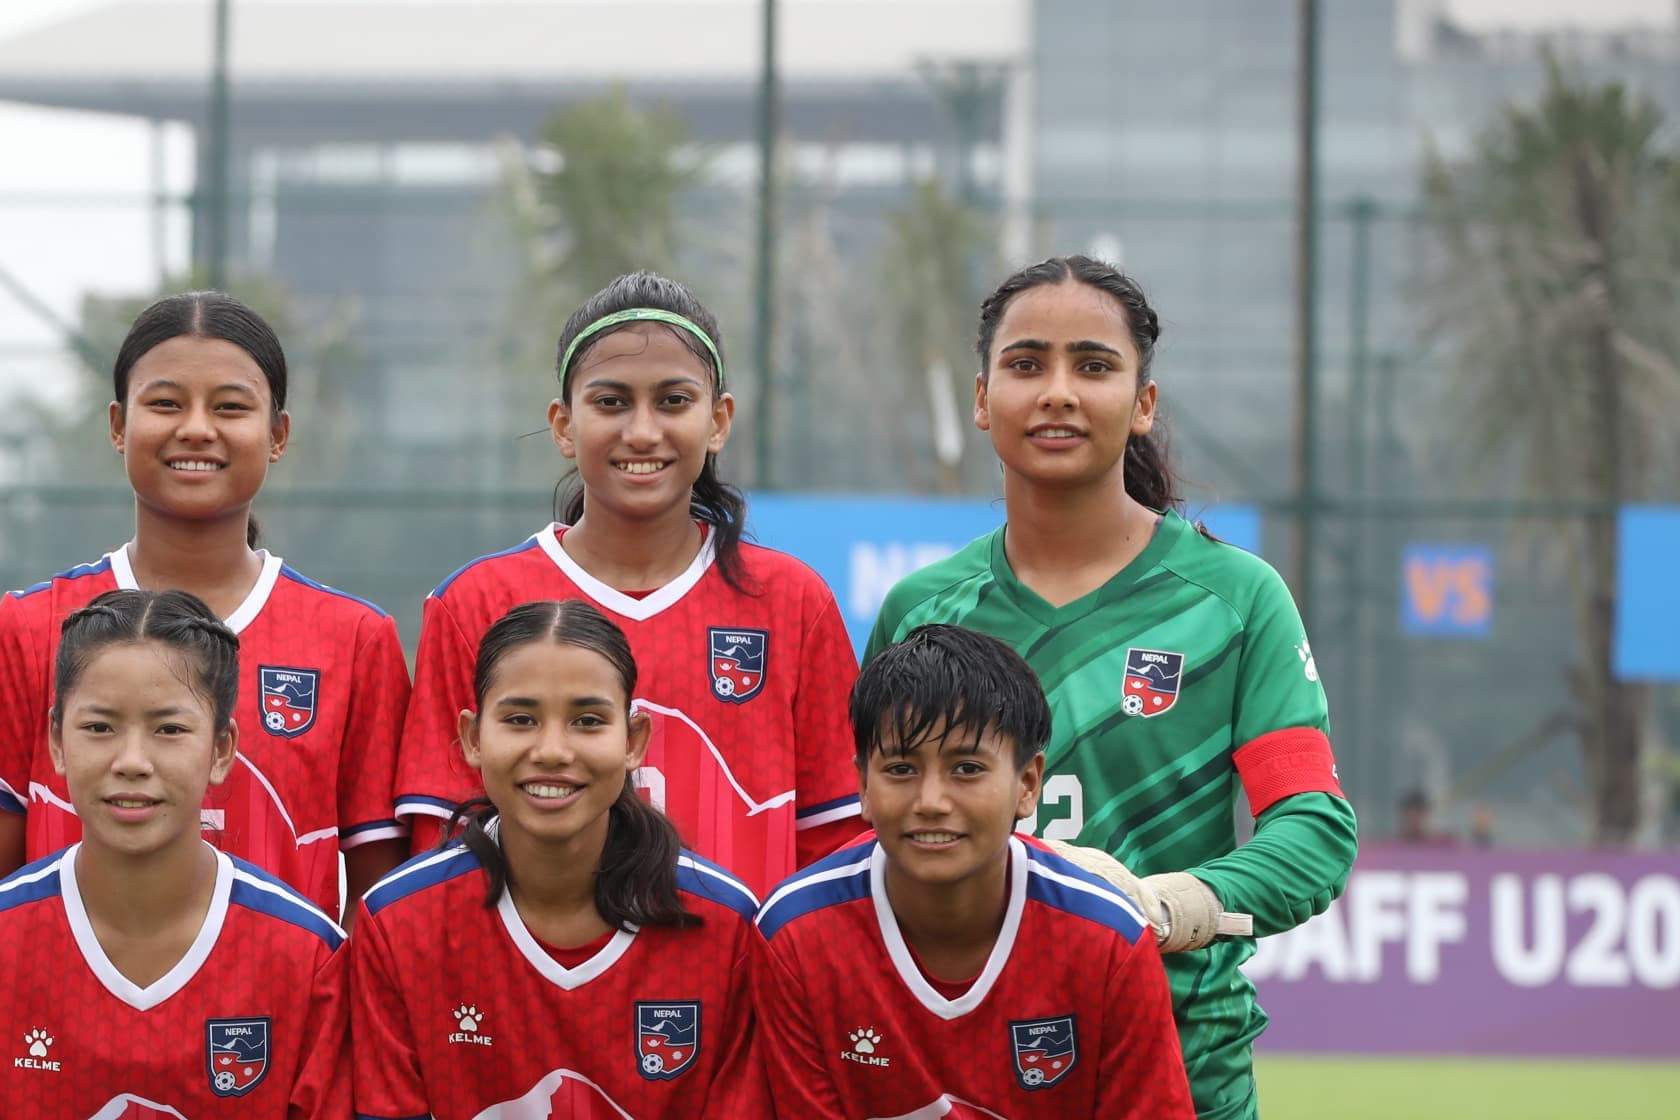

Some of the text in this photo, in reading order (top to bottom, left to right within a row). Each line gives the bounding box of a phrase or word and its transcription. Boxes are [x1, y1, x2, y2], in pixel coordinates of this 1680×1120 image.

[1406, 555, 1491, 623] VS
[725, 635, 752, 645] NEPAL
[1141, 653, 1168, 664] NEPAL
[276, 673, 302, 684] NEPAL
[1241, 869, 1680, 988] AFF U20
[653, 1010, 681, 1018] NEPAL
[225, 1027, 252, 1036] NEPAL
[1028, 1025, 1058, 1036] NEPAL
[449, 1033, 492, 1046] KELME
[841, 1051, 890, 1067] KELME
[14, 1058, 60, 1072] KELME
